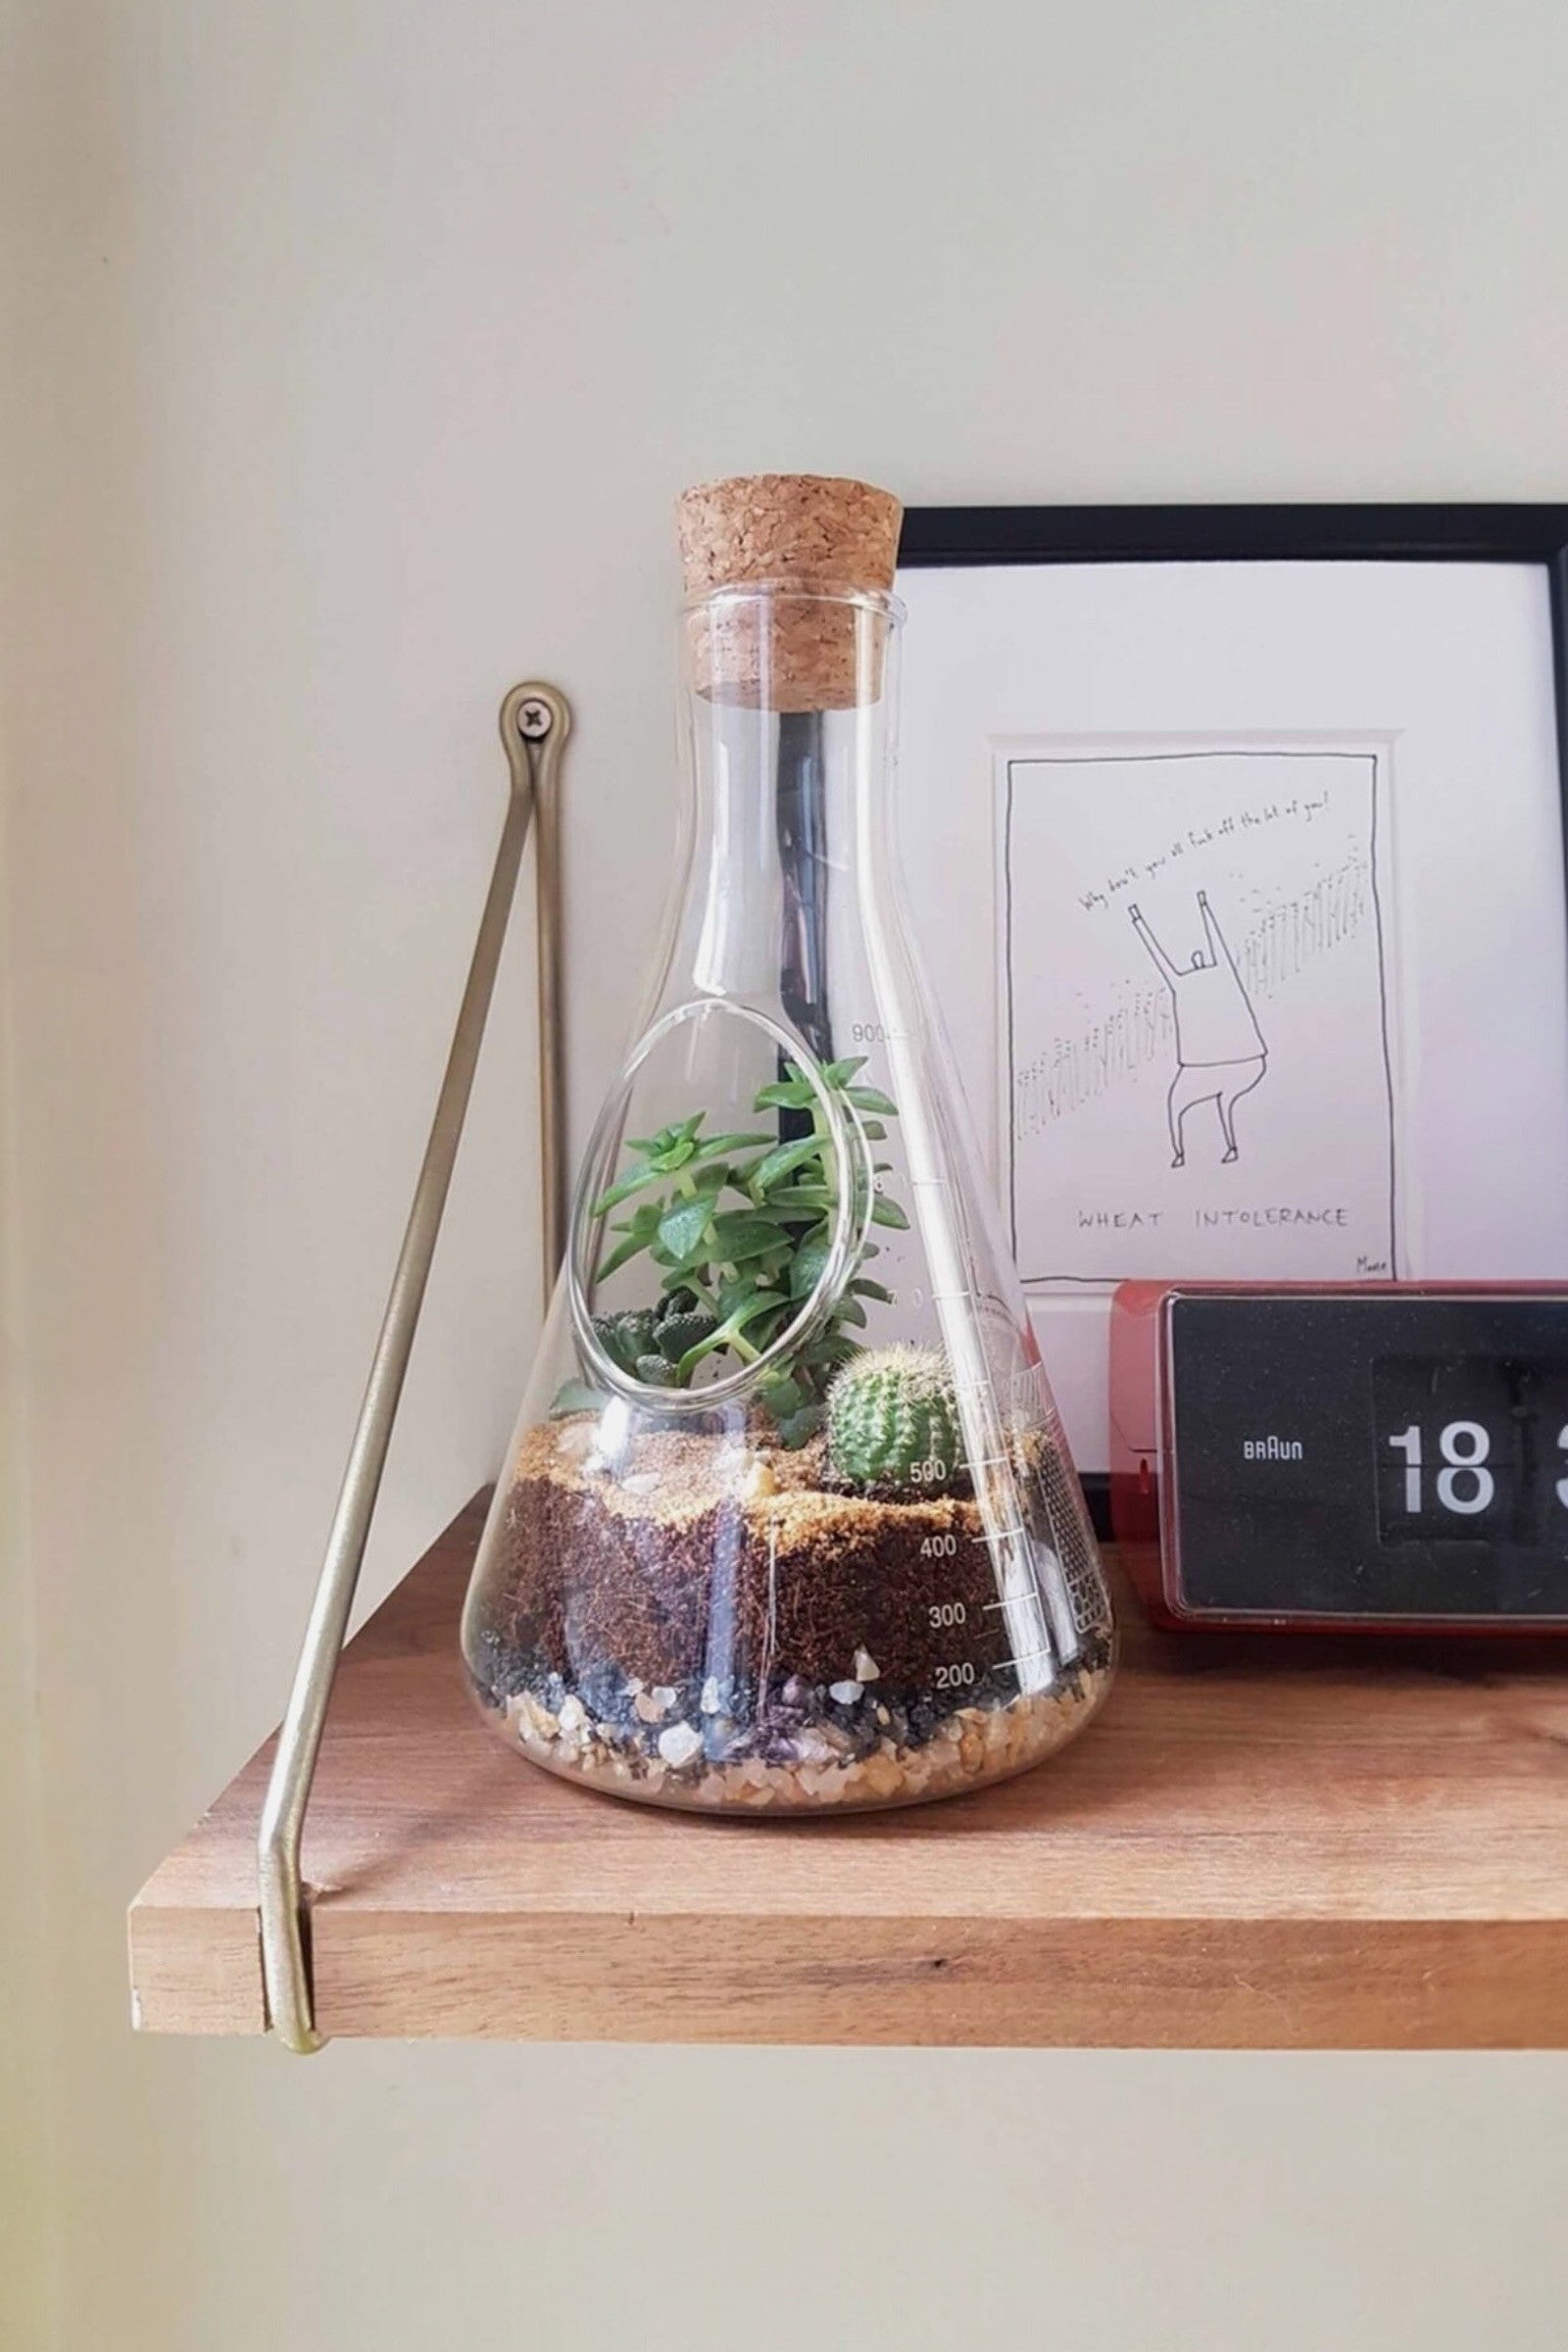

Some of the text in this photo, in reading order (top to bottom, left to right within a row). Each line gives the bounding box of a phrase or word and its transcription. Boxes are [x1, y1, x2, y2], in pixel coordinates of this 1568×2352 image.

[1077, 891, 1108, 910] Why
[1146, 857, 1166, 880] you
[1240, 811, 1260, 828] the
[1286, 800, 1298, 814] of
[852, 1023, 885, 1044] 900
[1078, 1207, 1348, 1228] WHEAT INTOLERANCE
[1243, 1435, 1303, 1461] BRAUN
[909, 1458, 948, 1484] 500
[1388, 1420, 1495, 1515] 18
[920, 1534, 957, 1559] 400
[929, 1602, 966, 1629] 300
[935, 1661, 976, 1690] 200
